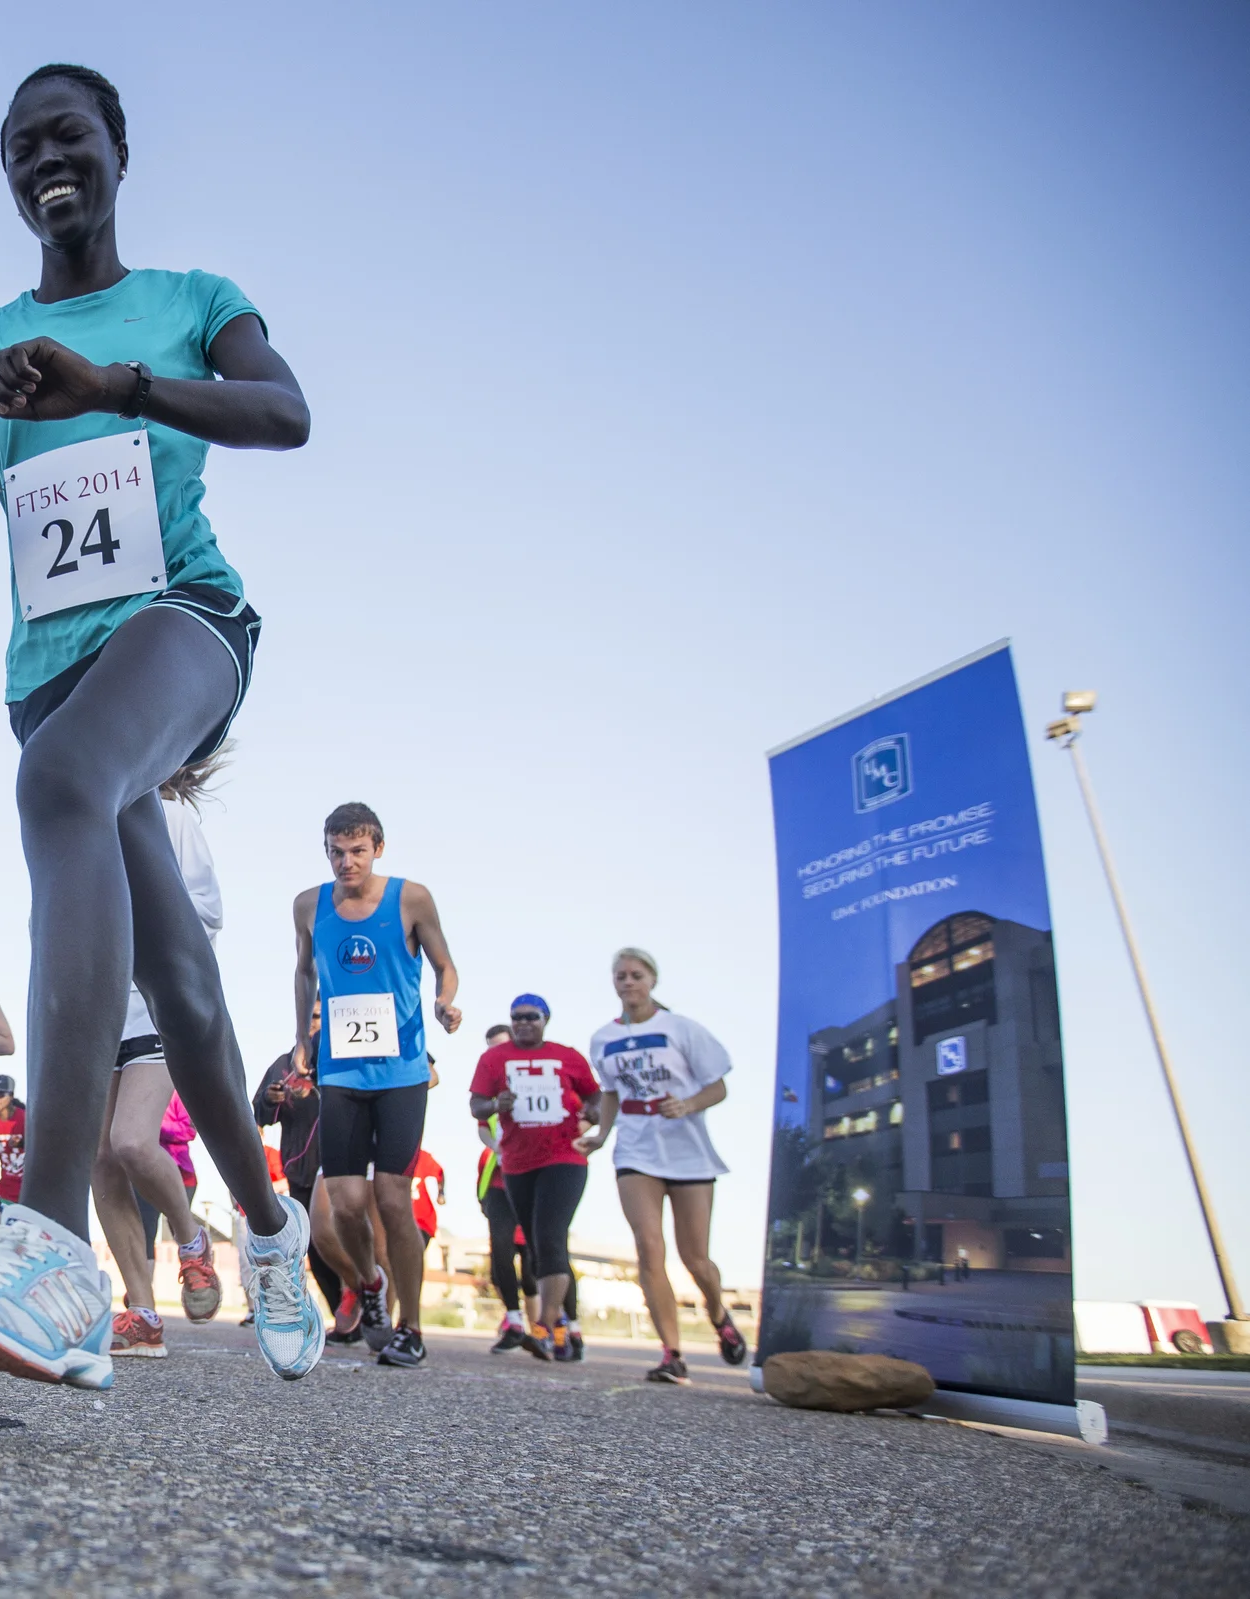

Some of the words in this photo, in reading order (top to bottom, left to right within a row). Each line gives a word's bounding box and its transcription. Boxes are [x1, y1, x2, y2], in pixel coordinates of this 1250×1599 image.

[15, 481, 69, 518] FT5K
[76, 465, 142, 499] 2014
[41, 507, 121, 580] 24
[863, 758, 900, 788] UMC
[797, 840, 872, 878] HONORING
[873, 827, 907, 848] THE
[802, 862, 875, 900] SECURING
[875, 849, 910, 871] THE
[831, 903, 860, 921] UMC
[860, 874, 959, 910] FOUNDATION
[333, 1007, 360, 1019] FT5K
[363, 1006, 390, 1017] 2014
[346, 1021, 379, 1044] 25
[525, 1095, 549, 1113] 10
